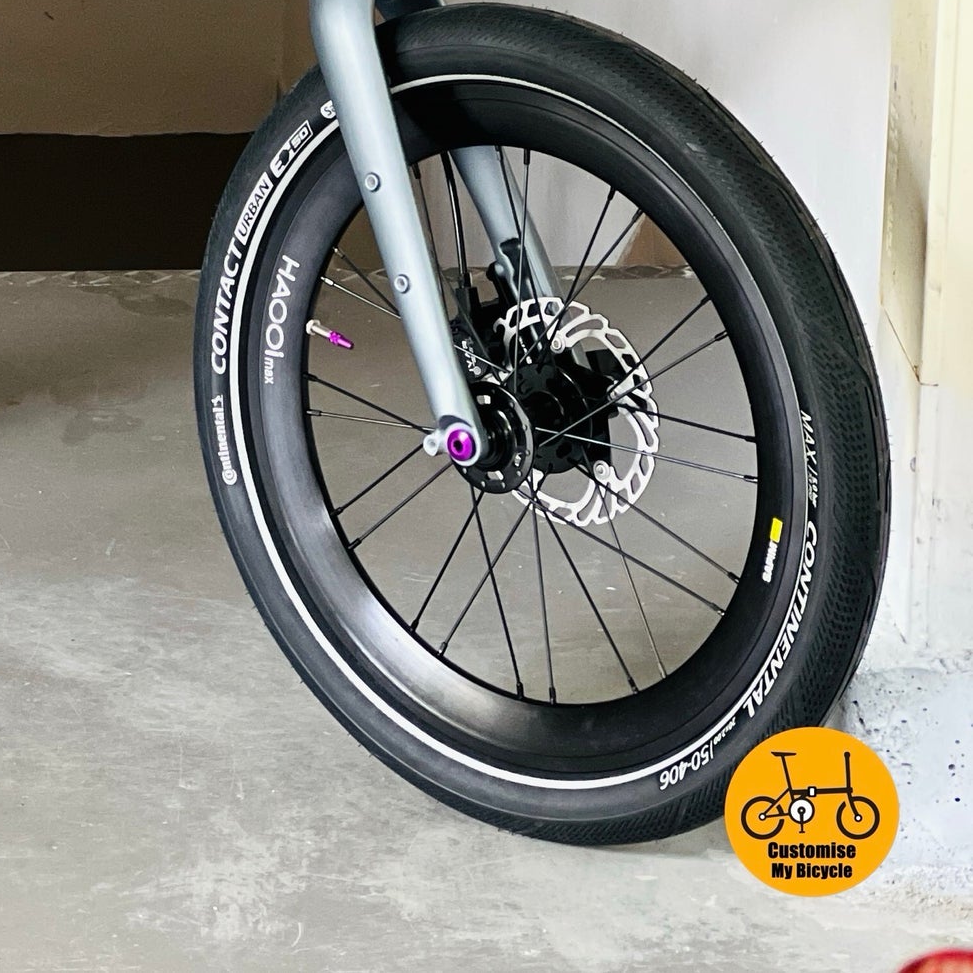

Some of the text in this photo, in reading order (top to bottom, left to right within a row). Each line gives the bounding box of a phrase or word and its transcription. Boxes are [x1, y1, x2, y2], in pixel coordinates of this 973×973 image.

[211, 178, 271, 375] CONTACT URBAN
[264, 355, 275, 385] max
[211, 401, 238, 486] Continental
[742, 520, 818, 719] CONTINENTAL
